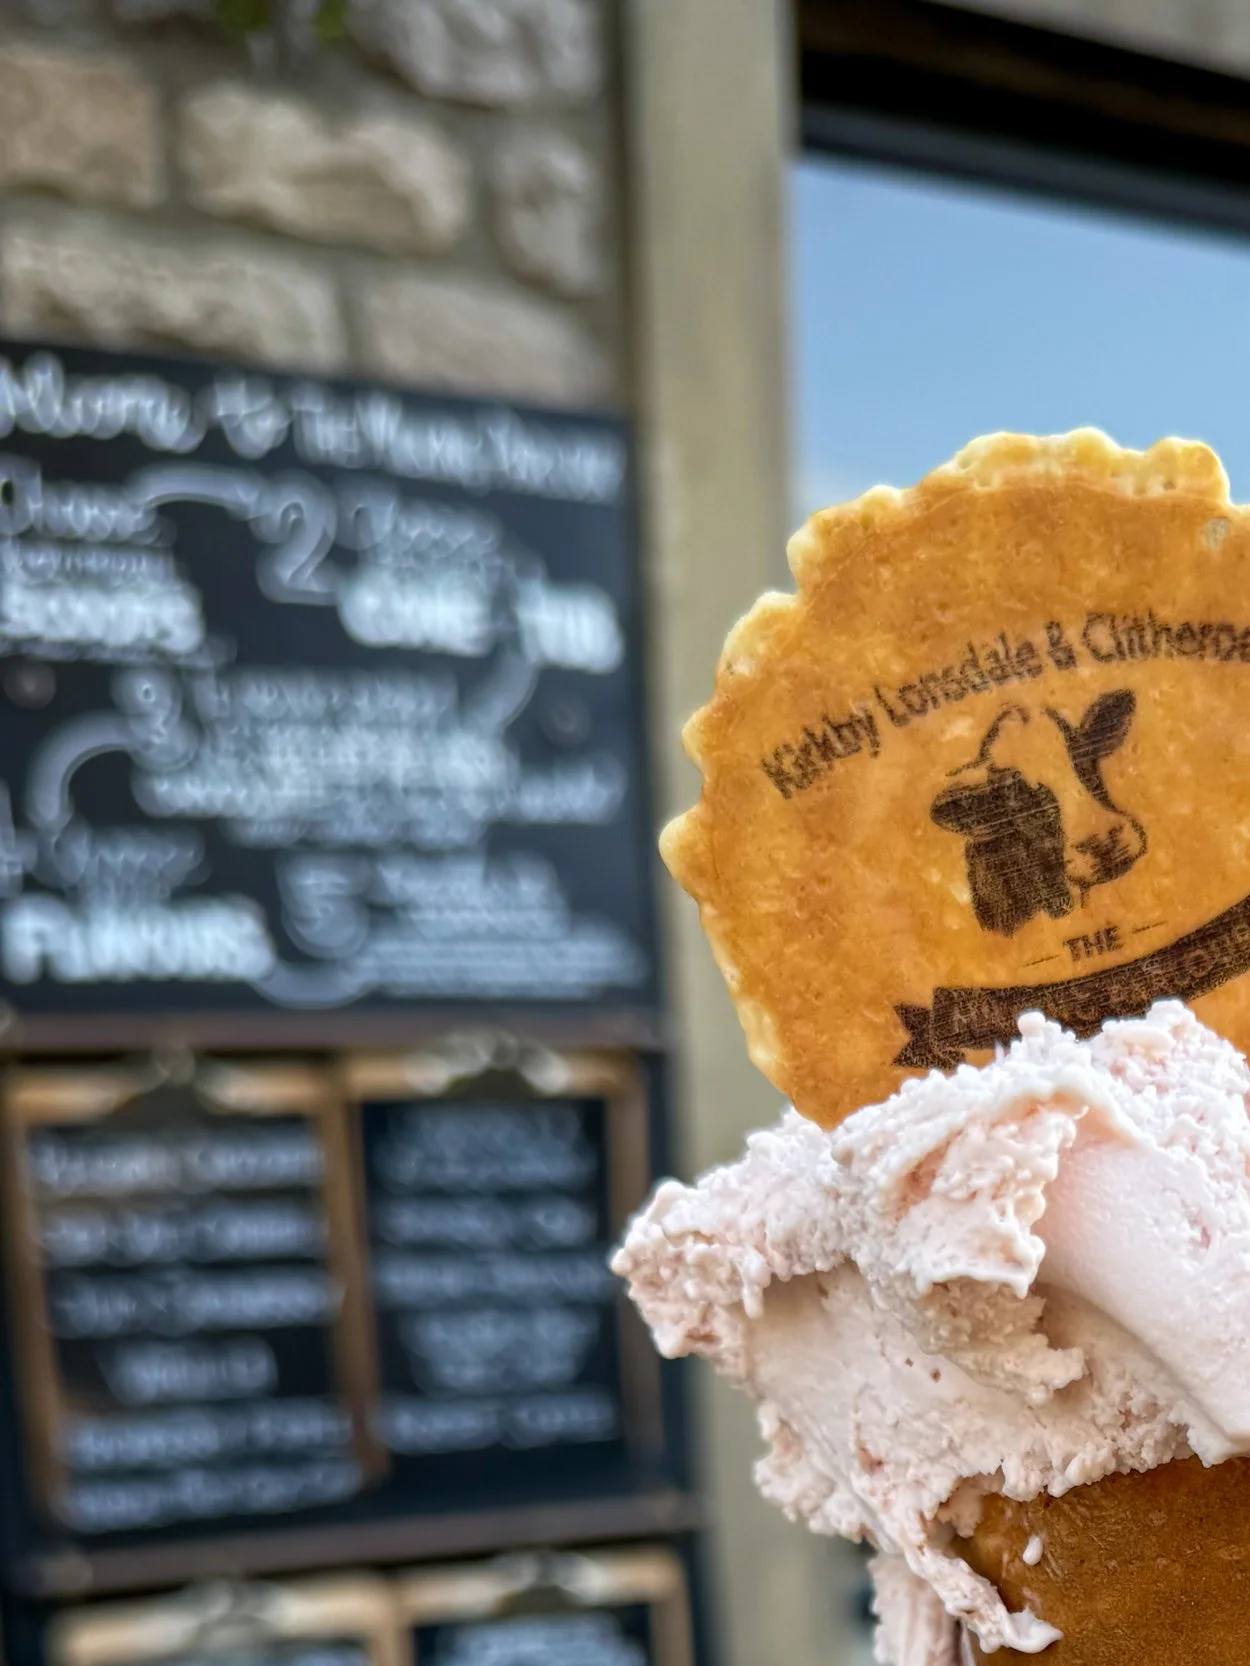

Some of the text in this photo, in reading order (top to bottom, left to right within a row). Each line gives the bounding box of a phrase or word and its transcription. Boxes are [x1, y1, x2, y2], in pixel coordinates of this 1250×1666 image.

[761, 711, 881, 799] Kirkby
[872, 630, 1043, 728] Lonsdale
[1046, 620, 1077, 671] &
[1063, 925, 1123, 961] THE
